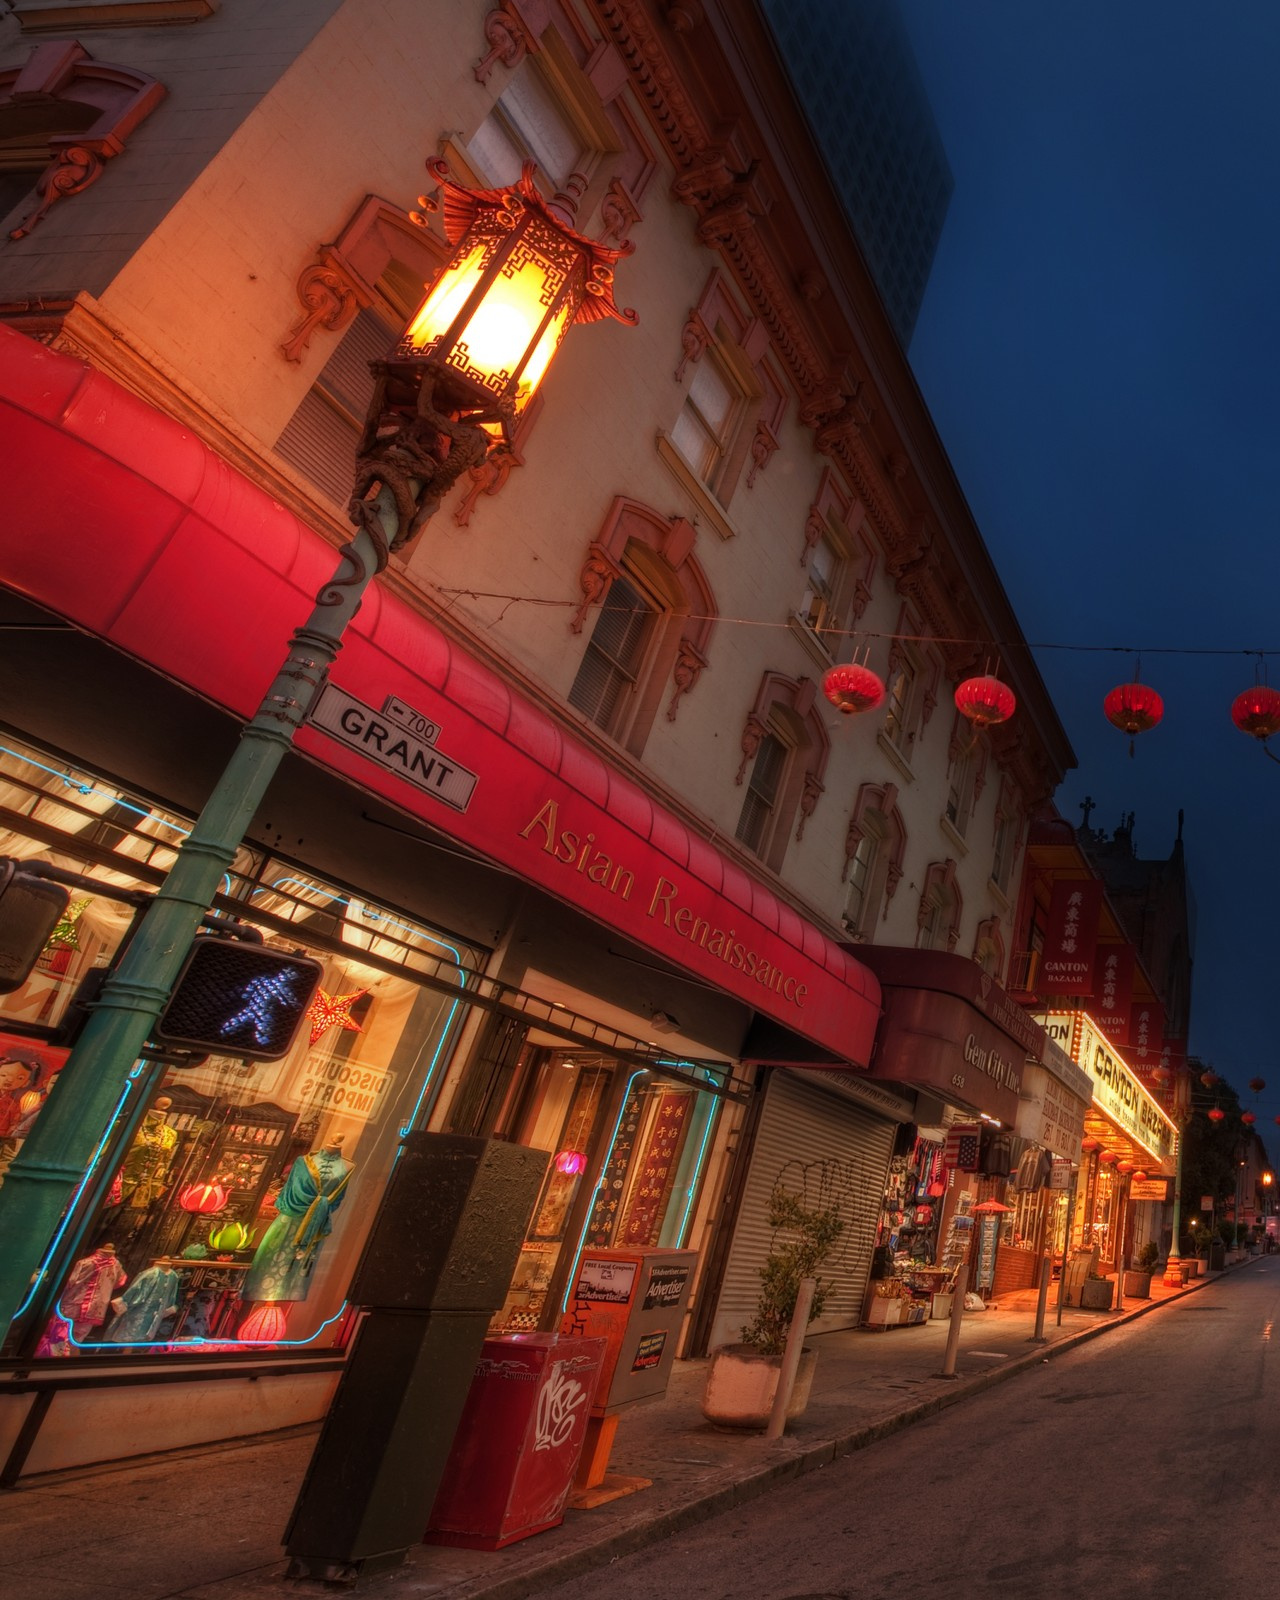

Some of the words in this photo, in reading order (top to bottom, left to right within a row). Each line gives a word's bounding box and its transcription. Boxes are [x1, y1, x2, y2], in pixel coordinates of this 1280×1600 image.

[407, 711, 435, 739] 700
[340, 708, 454, 788] GRANT
[518, 799, 636, 901] Asian
[646, 875, 809, 1008] Renaissance
[1044, 961, 1089, 973] CANTON
[1047, 974, 1083, 984] BAZAAR
[1095, 1016, 1126, 1026] ANTON
[964, 1033, 988, 1073] Gem
[987, 1048, 1006, 1090] City
[952, 1073, 966, 1089] 658
[1093, 1043, 1140, 1114] CANTON
[612, 1264, 635, 1272] Coupons
[646, 1279, 685, 1297] Advertiser
